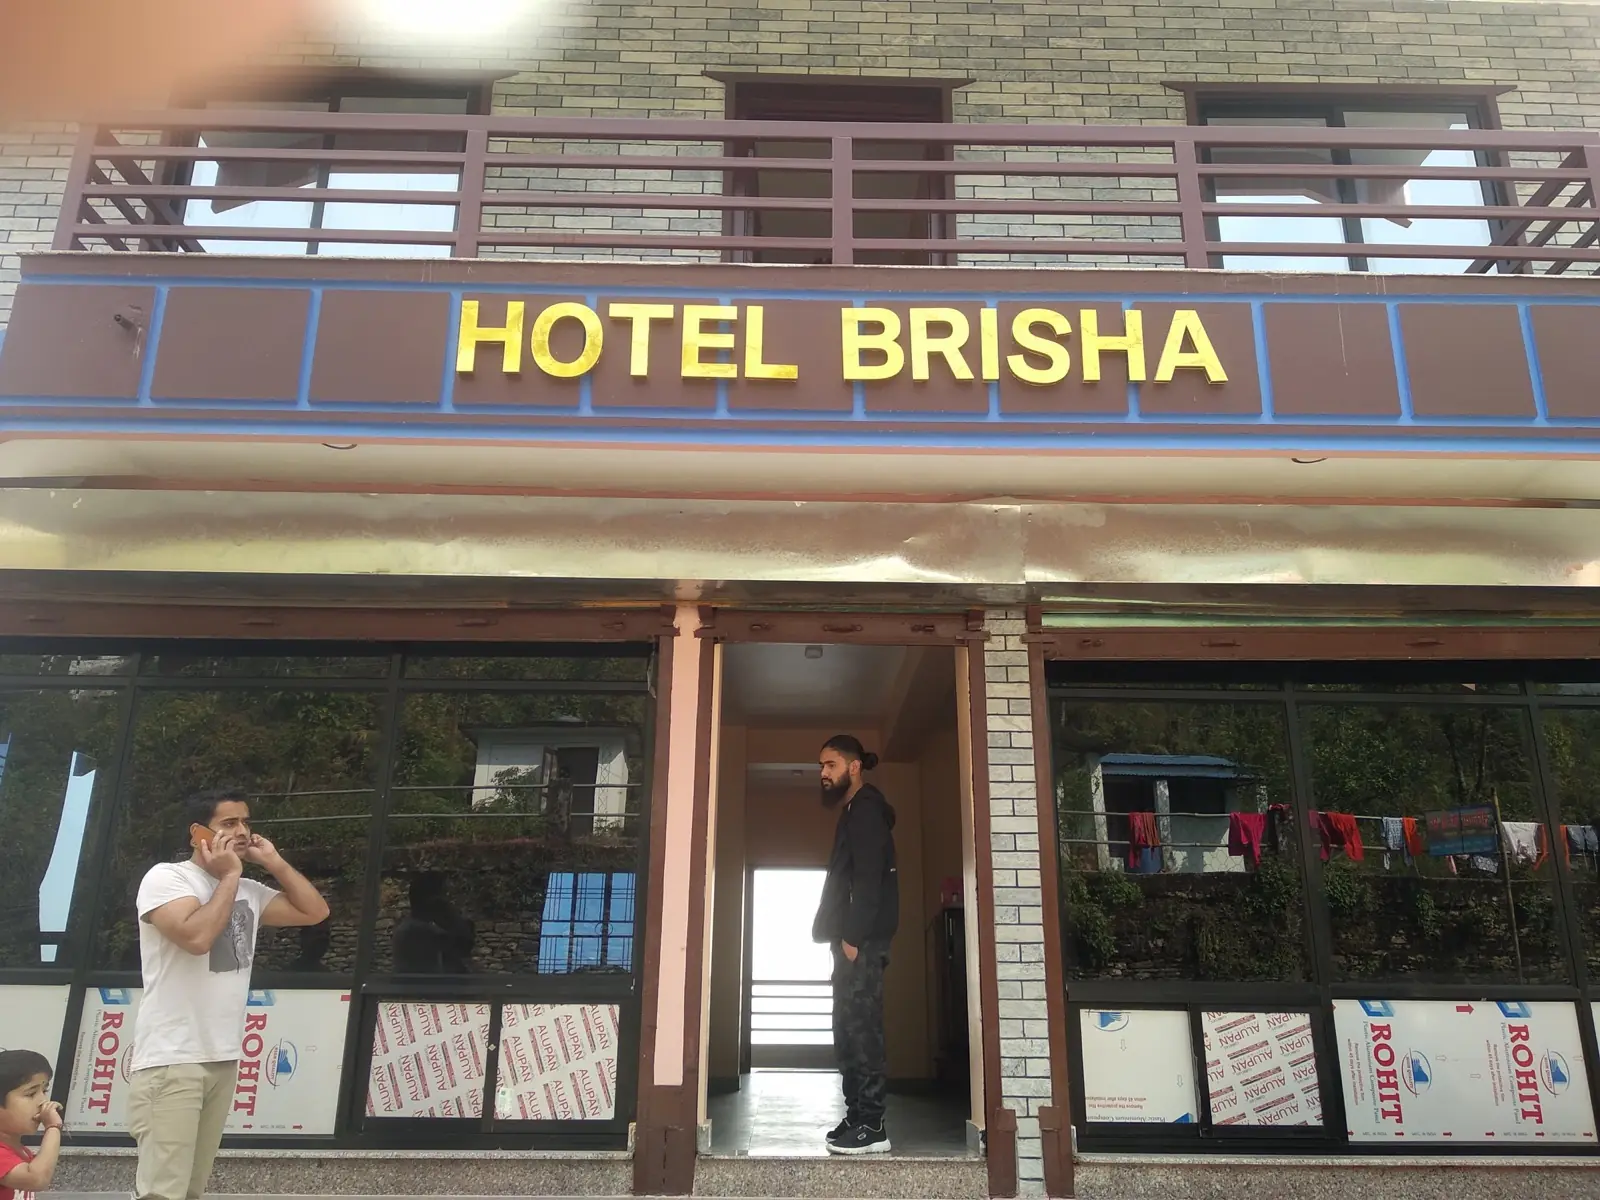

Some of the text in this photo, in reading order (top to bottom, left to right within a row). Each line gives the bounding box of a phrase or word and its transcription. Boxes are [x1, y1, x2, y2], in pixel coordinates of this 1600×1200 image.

[456, 300, 1229, 386] HOTEL BRISHA
[537, 1025, 558, 1072] ALUPAN
[564, 1014, 585, 1061] ALUPAN
[590, 1004, 610, 1050] ALUPAN
[1219, 1022, 1260, 1047] ALUPAN
[88, 1011, 125, 1114] ROHIT
[234, 1013, 268, 1116] ROHIT
[401, 1055, 420, 1101] ALUPAN
[427, 1044, 447, 1091] ALUPAN
[454, 1033, 473, 1080] ALUPAN
[512, 1036, 532, 1082] ALUPAN
[1231, 1048, 1273, 1074] ALUPAN
[1370, 1023, 1404, 1124] ROHIT
[1508, 1024, 1543, 1125] ROHIT
[374, 1065, 393, 1112] ALUPAN
[553, 1080, 571, 1119] ALUPA
[579, 1069, 600, 1117] ALUPAN
[1211, 1095, 1238, 1114] ALUP
[1244, 1076, 1286, 1101] ALUPAN
[1257, 1103, 1299, 1125] ALUPAN
